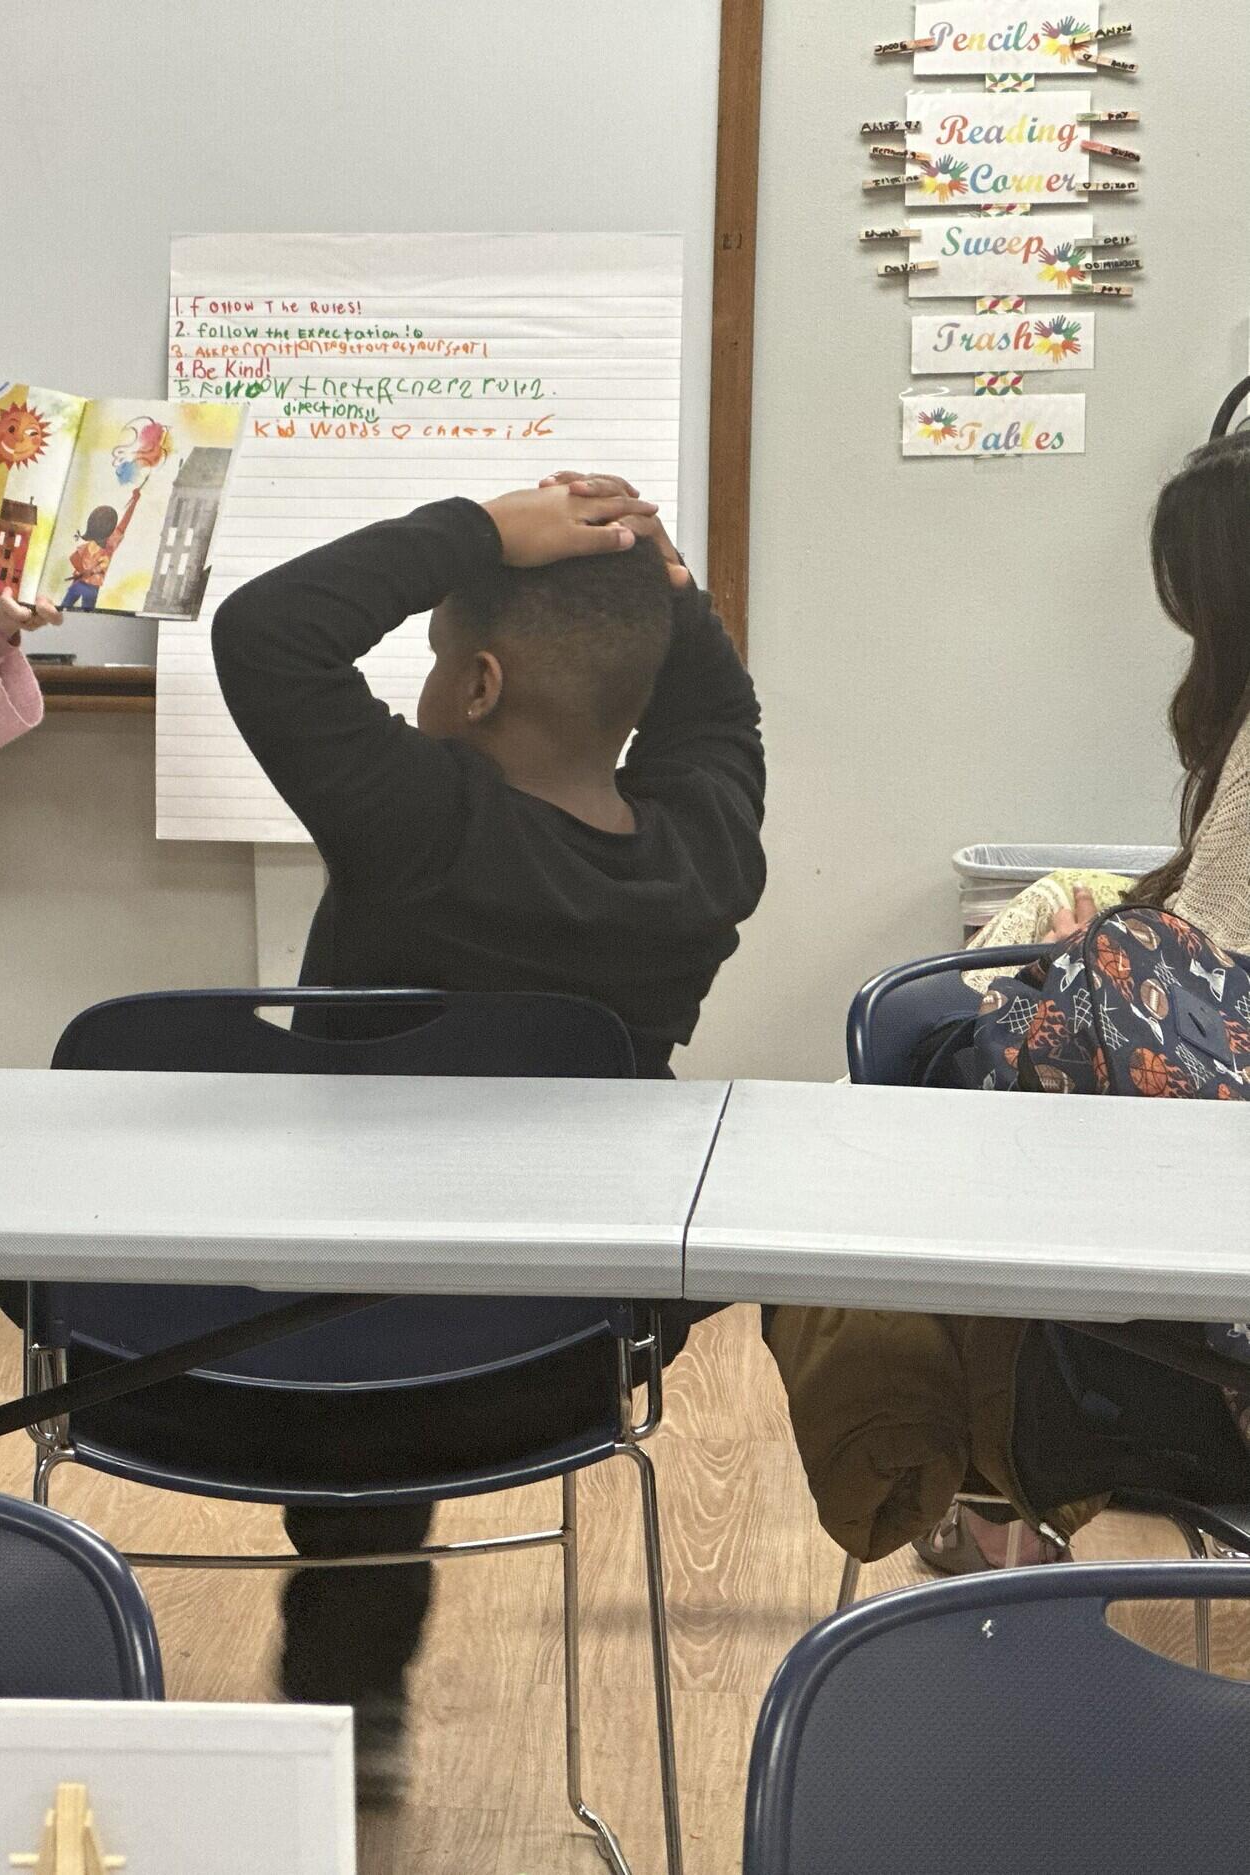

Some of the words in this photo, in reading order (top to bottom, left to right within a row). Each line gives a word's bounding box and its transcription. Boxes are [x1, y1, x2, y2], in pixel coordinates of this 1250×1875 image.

[929, 21, 1041, 52] Pencils
[936, 113, 1078, 153] Reading
[969, 164, 1076, 194] Corner
[941, 226, 1044, 264] Sweep
[265, 327, 290, 340] the
[932, 321, 1035, 352] Trash
[193, 360, 218, 379] Be
[225, 358, 271, 378] Kind!
[954, 421, 1065, 451] Tables
